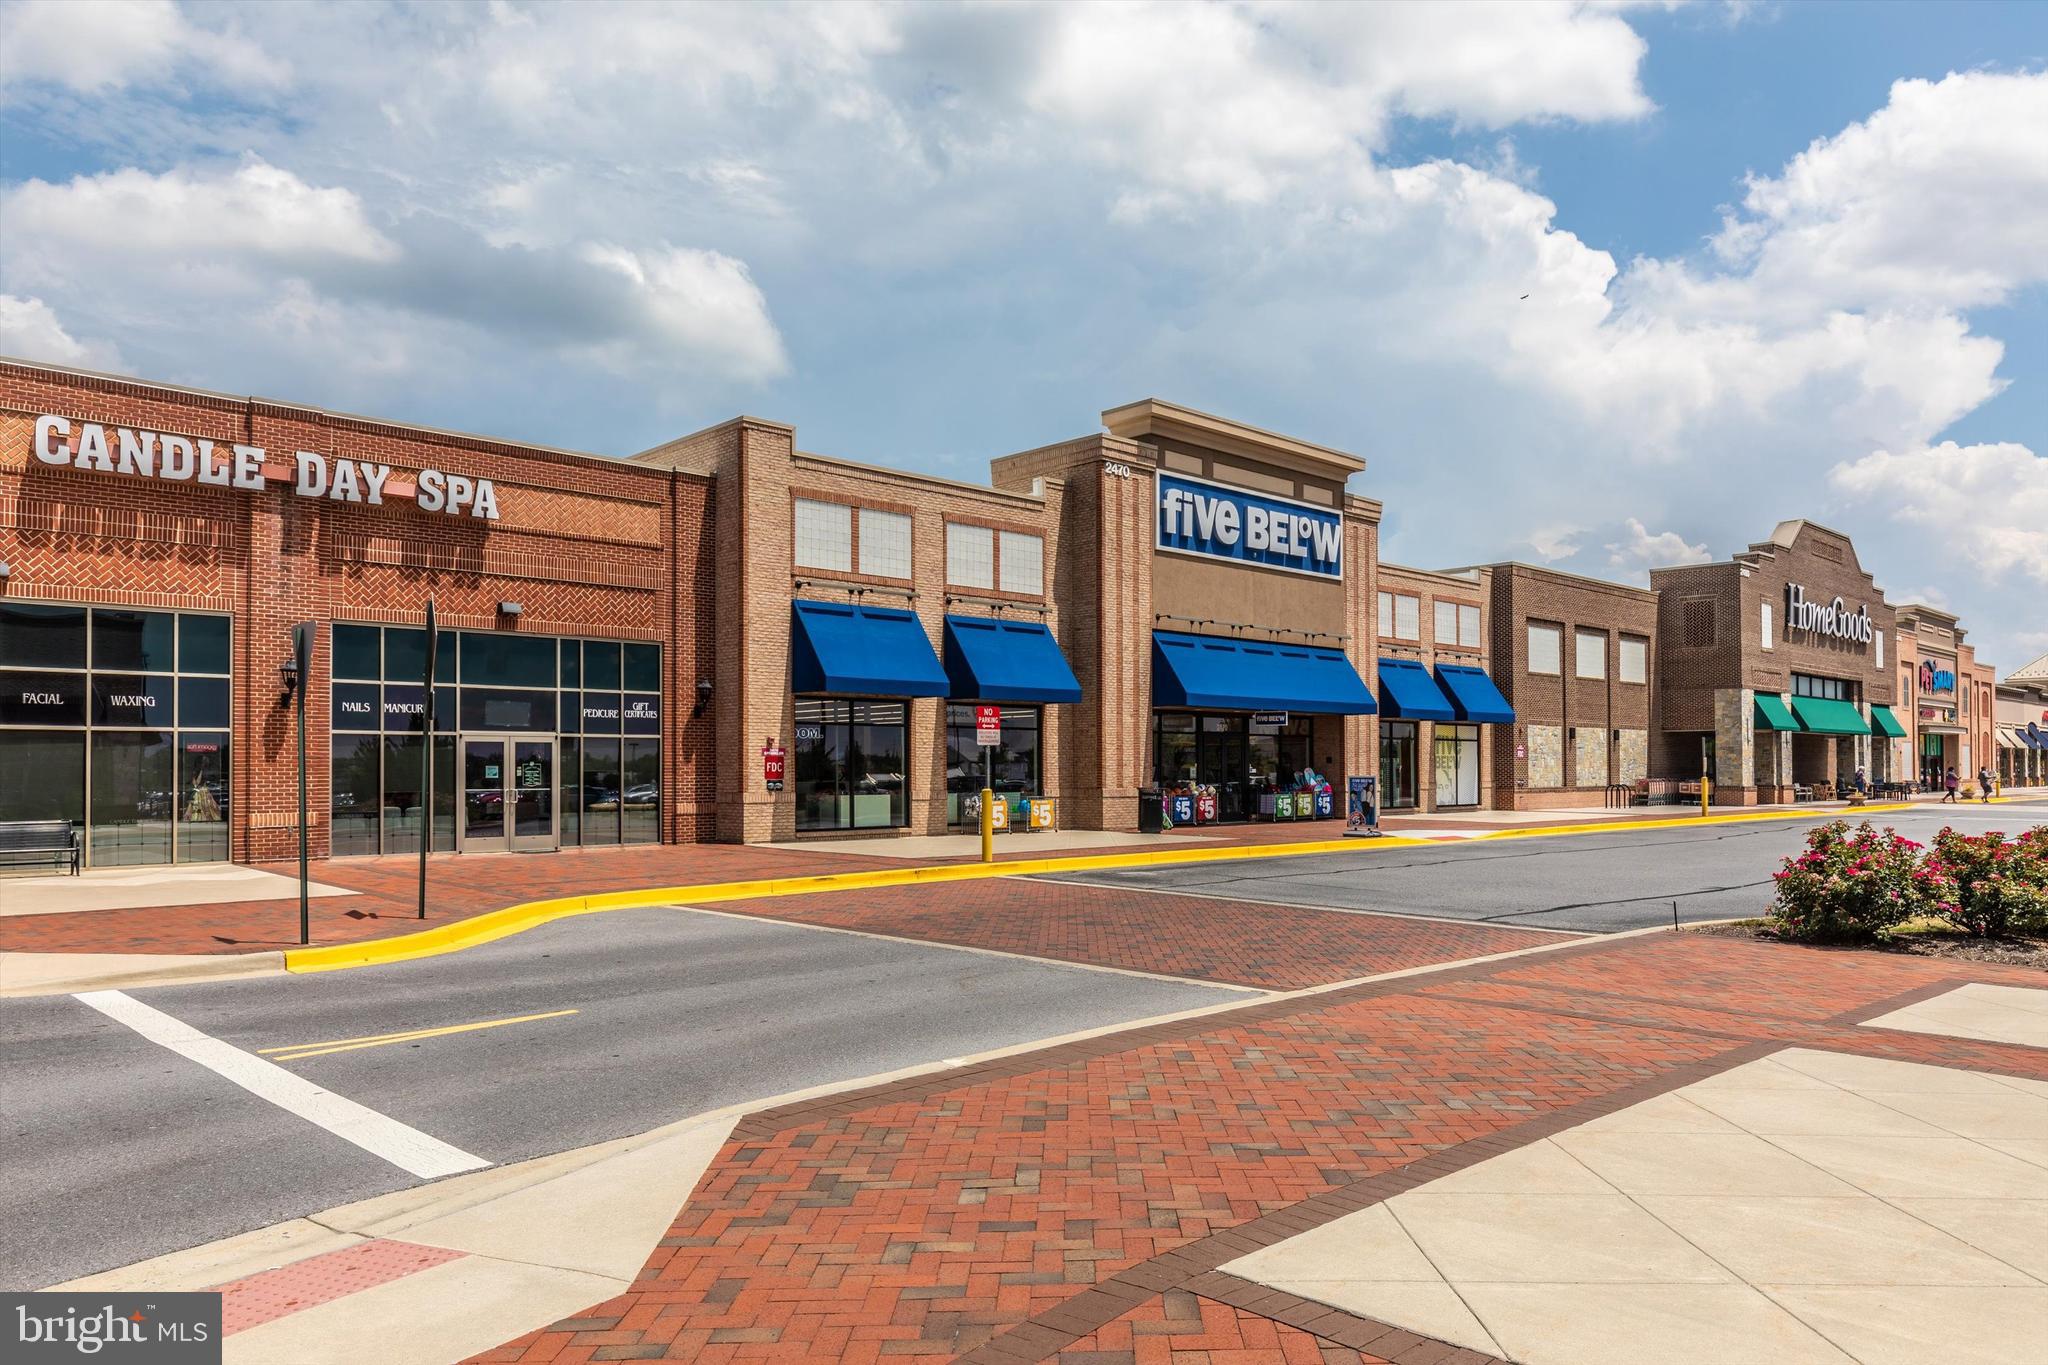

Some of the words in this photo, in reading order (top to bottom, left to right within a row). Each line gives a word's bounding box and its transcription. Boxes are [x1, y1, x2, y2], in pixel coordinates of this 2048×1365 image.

[35, 415, 265, 491] CANDLE
[295, 451, 390, 505] DAY
[417, 469, 500, 520] SPA
[1105, 461, 1130, 478] 2470
[1785, 582, 1872, 644] HomeGoods
[22, 692, 64, 705] FACIAL
[110, 695, 156, 707] WAXING
[341, 702, 371, 712] NAILS
[632, 702, 649, 711] GIFT
[383, 703, 424, 714] MANICUR
[583, 708, 619, 719] PEDICURE
[624, 710, 658, 719] CERTIFICATES
[983, 708, 993, 716] NO
[766, 762, 783, 772] FDC
[1176, 800, 1191, 820] $5
[1200, 800, 1215, 820] $5
[1278, 798, 1292, 816] $5
[1299, 797, 1311, 815] $5
[1318, 796, 1331, 815] $5
[992, 805, 1005, 827] 5
[1033, 804, 1052, 826] $5
